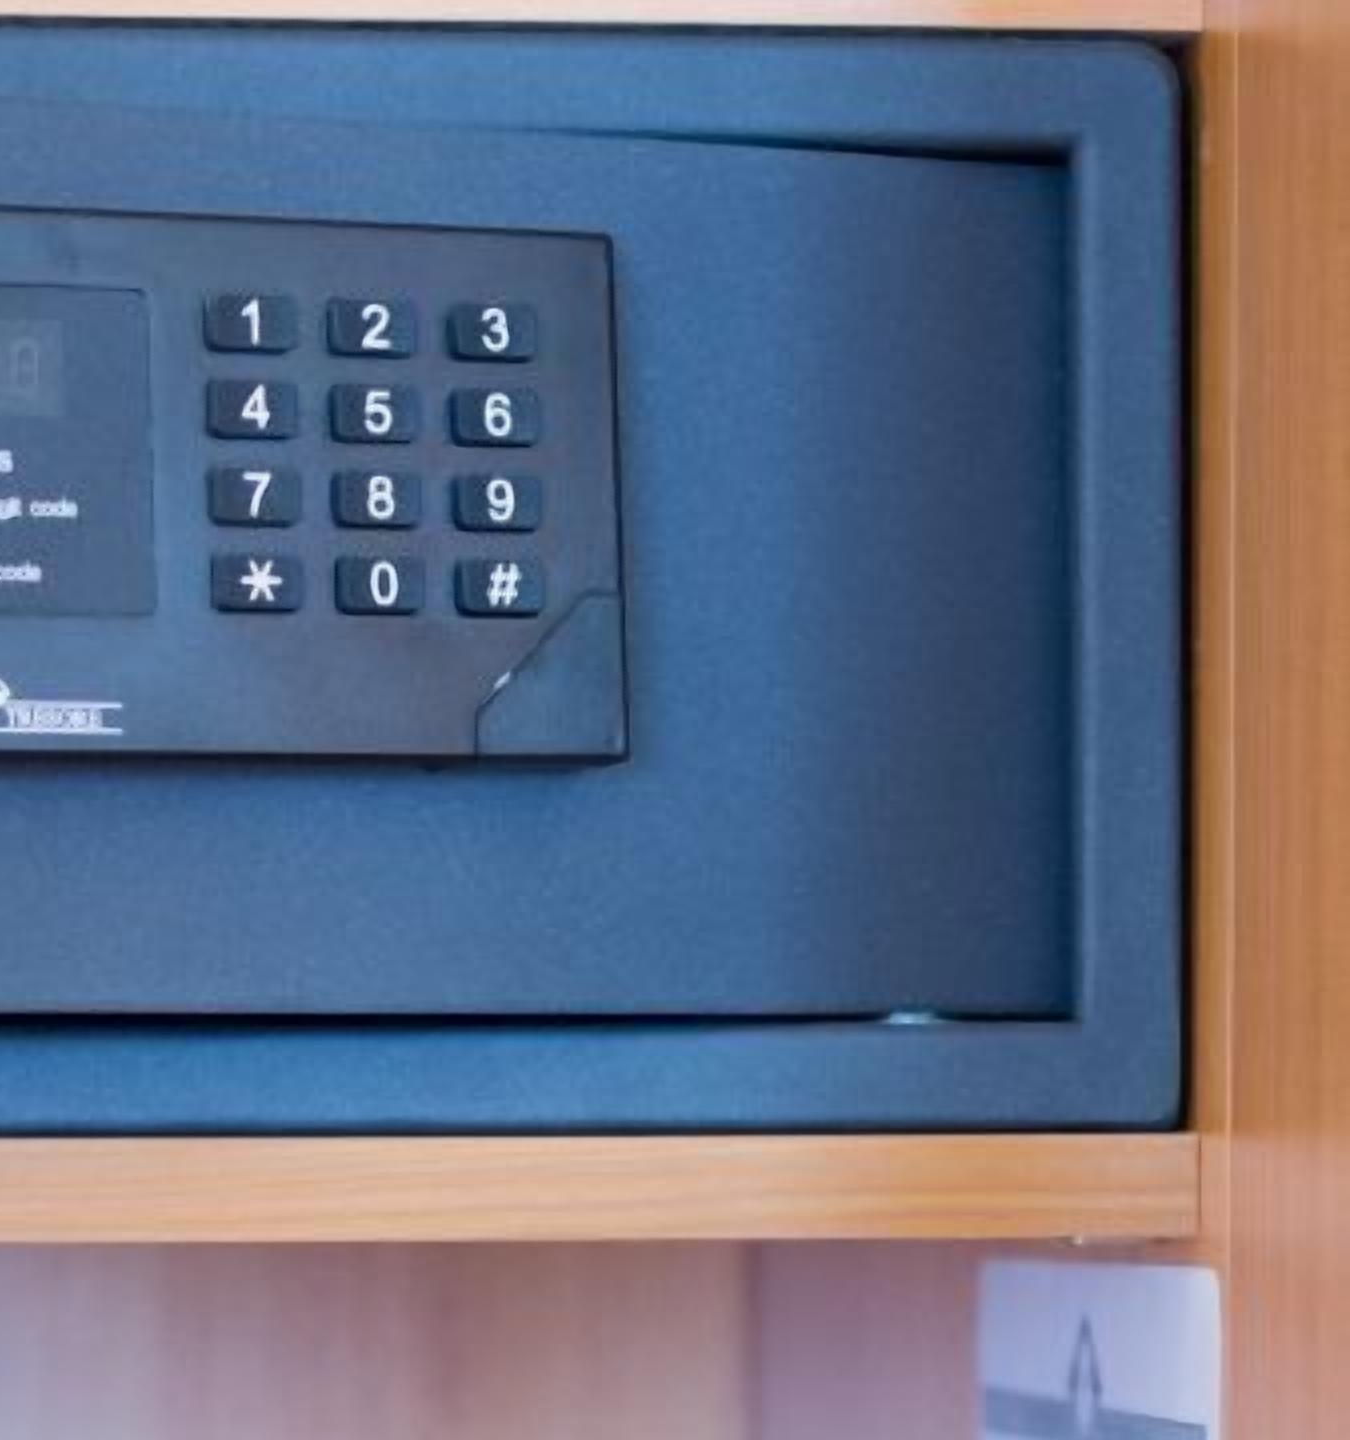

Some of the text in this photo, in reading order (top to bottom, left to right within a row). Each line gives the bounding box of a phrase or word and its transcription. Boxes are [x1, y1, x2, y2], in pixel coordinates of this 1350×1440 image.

[241, 298, 510, 353] 1 2 3
[241, 384, 513, 437] 4 5 6
[30, 497, 79, 518] code
[242, 470, 515, 523] 7 8 9
[369, 560, 399, 607] 0
[486, 562, 522, 607] #
